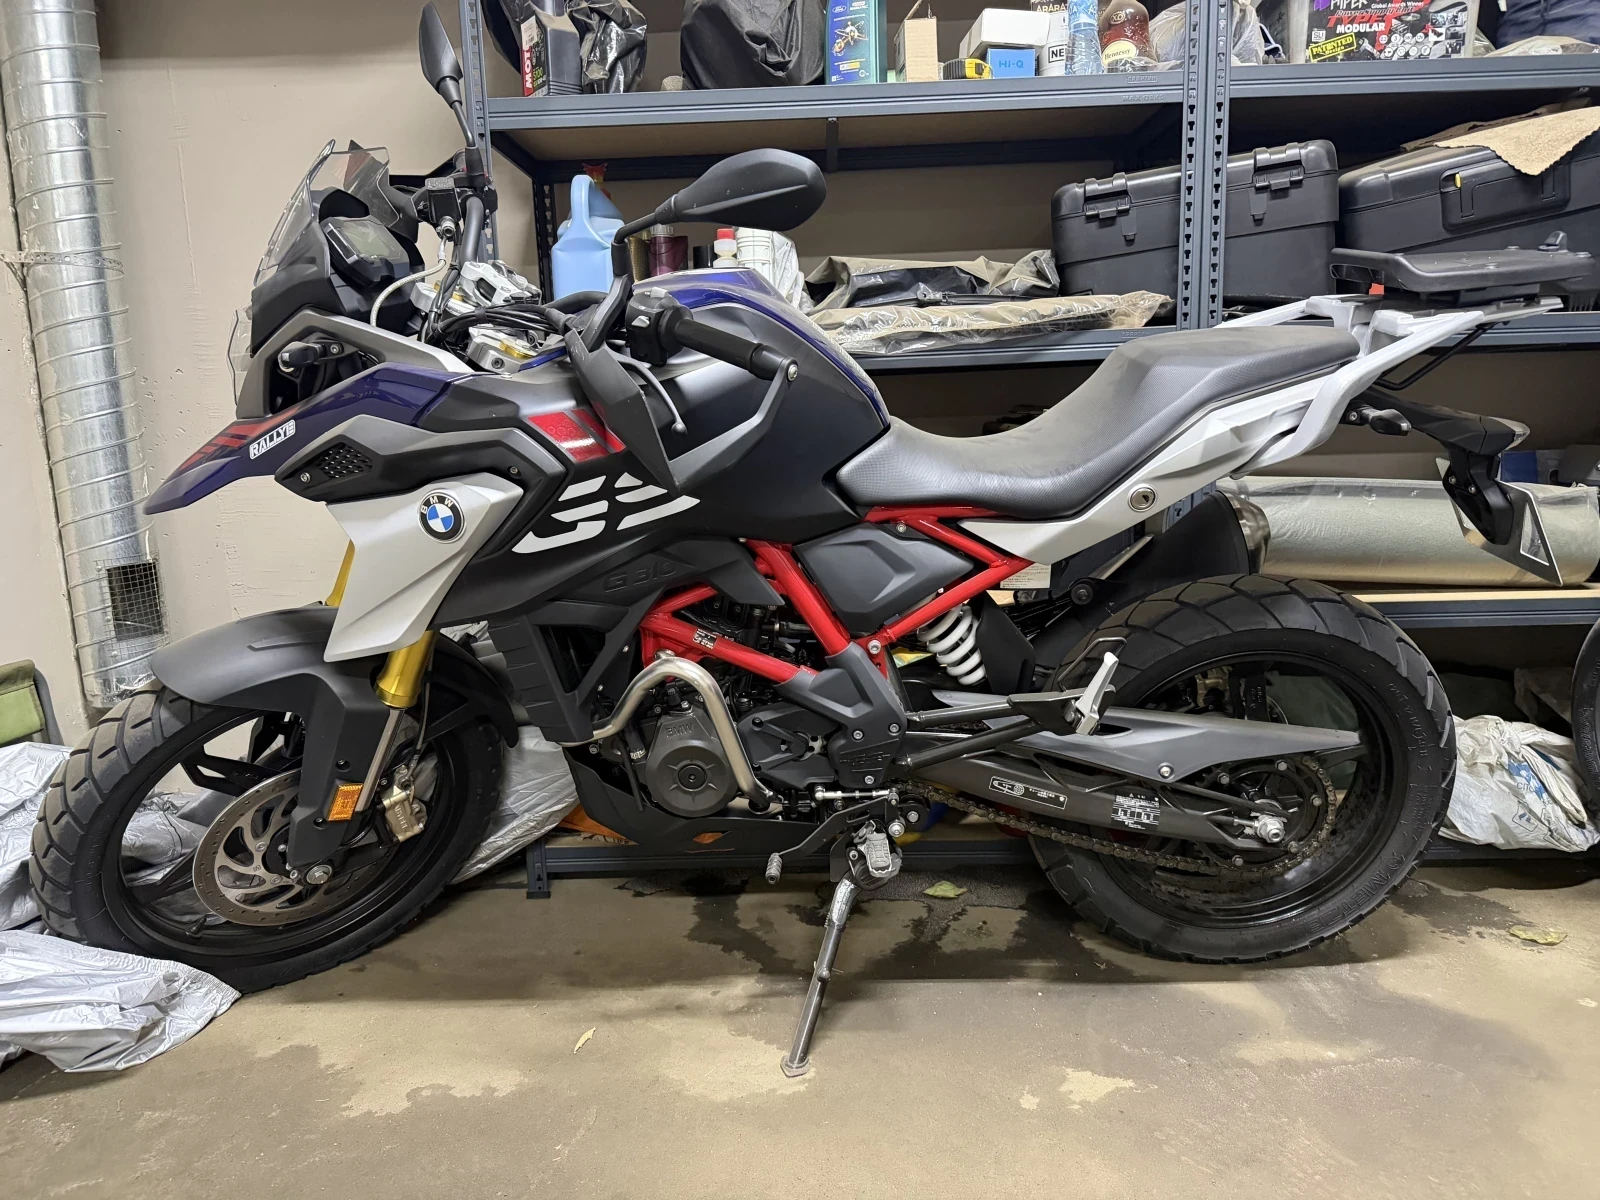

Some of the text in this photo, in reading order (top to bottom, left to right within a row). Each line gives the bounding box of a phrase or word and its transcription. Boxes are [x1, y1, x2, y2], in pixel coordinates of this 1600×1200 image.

[1336, 22, 1386, 34] MODULAR
[1312, 36, 1353, 55] PATENTED
[1104, 49, 1131, 60] Hennessy
[998, 60, 1024, 69] Hi-Q
[250, 420, 295, 459] RALLYE
[421, 495, 454, 514] BMW
[603, 561, 677, 593] G 310
[665, 722, 693, 738] BMW
